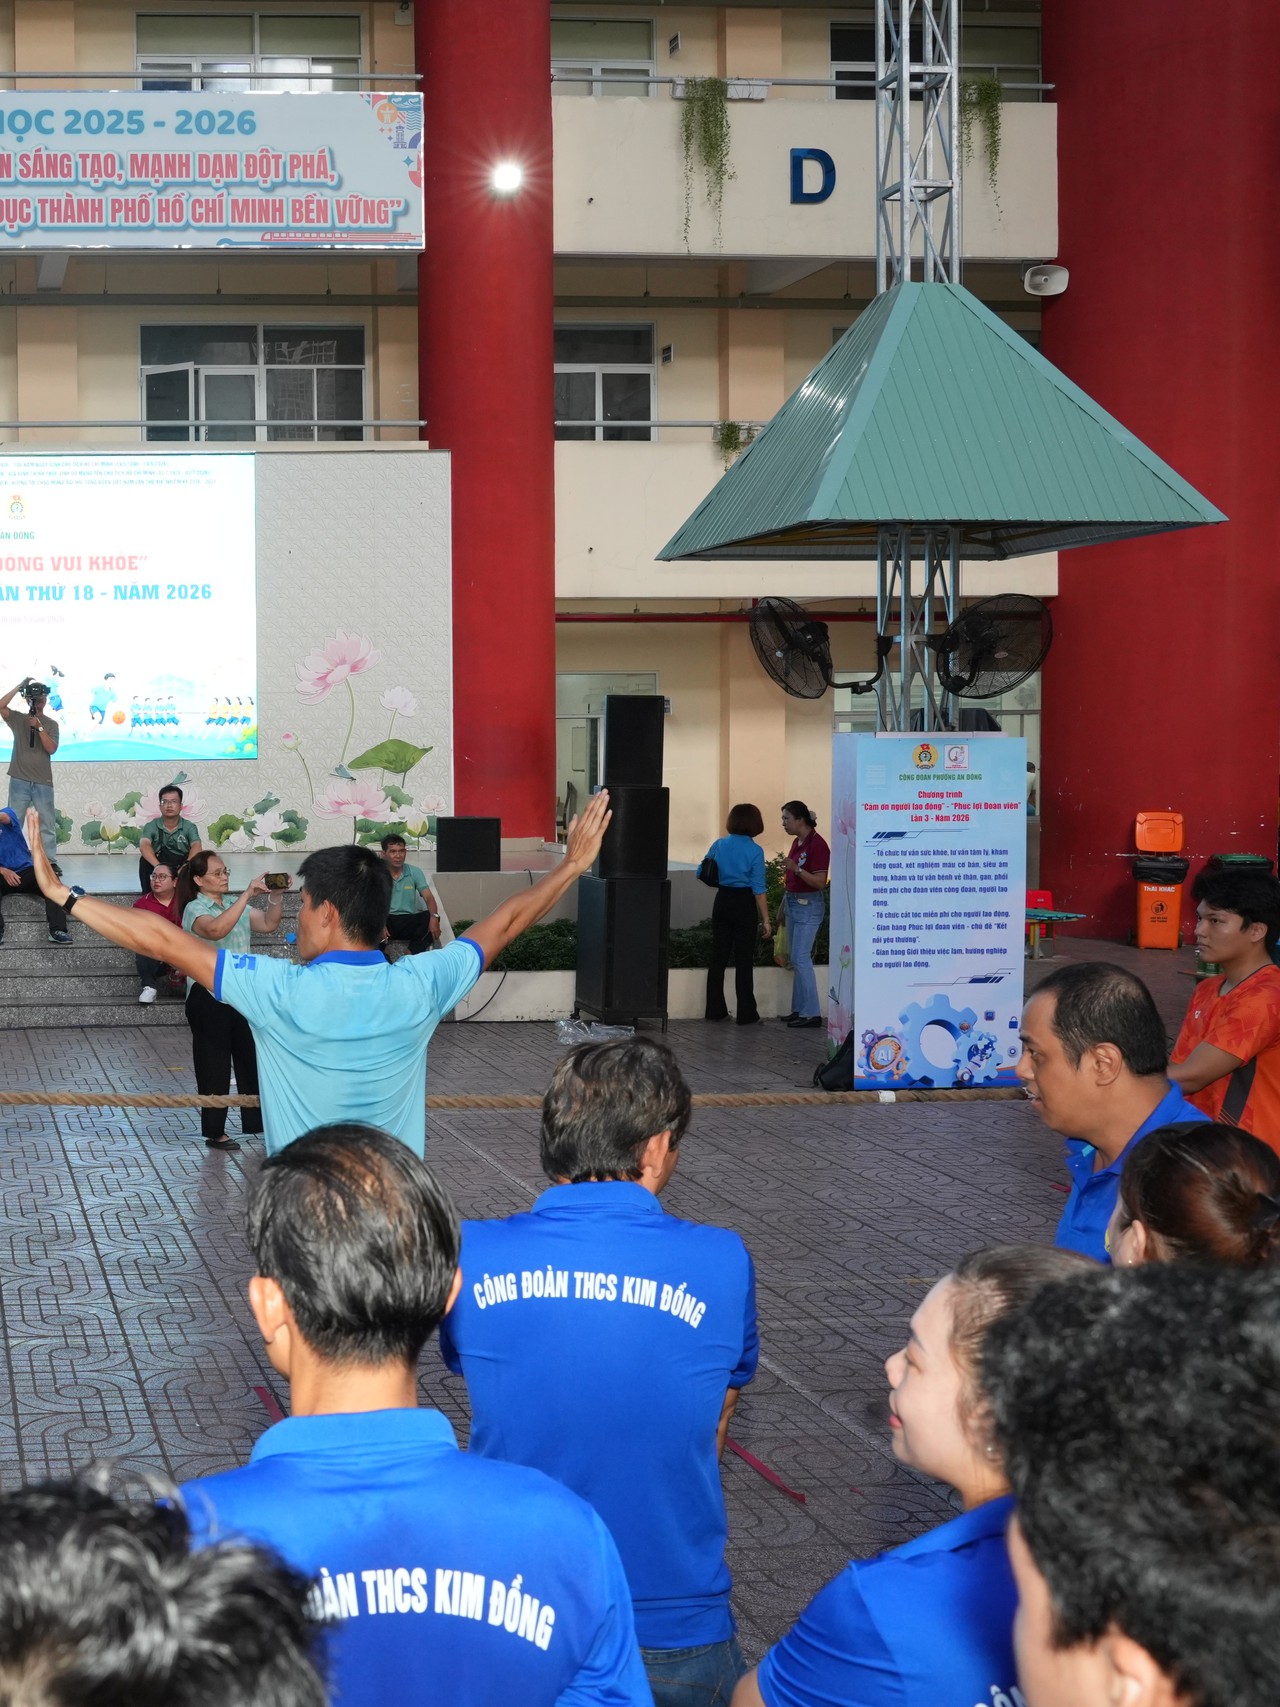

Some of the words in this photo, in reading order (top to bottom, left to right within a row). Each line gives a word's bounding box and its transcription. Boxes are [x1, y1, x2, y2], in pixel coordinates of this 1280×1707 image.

[64, 109, 145, 135] 2025
[154, 120, 165, 128] -
[175, 109, 256, 135] 2026
[19, 148, 72, 179] SÁNG
[79, 152, 123, 184] TẠO,
[130, 152, 190, 184] MẠNH
[198, 152, 236, 184] DẠN
[245, 147, 282, 184] ĐỘT
[289, 147, 336, 183] PHÁ,
[790, 148, 836, 205] D
[38, 192, 103, 224] THÀNH
[111, 191, 156, 224] PHỐ
[158, 191, 186, 224] HỒ
[191, 190, 227, 224] CHÍ
[231, 198, 284, 224] MINH
[291, 192, 328, 224] BỀN
[0, 531, 11, 540] AN
[50, 555, 82, 571] VUI
[74, 586, 95, 601] 18
[113, 581, 160, 601] NĂM
[167, 584, 212, 600] 2026
[473, 1270, 519, 1310] CÔNG
[521, 1265, 569, 1300] ĐOÀN
[573, 1271, 617, 1302] THCS
[621, 1276, 658, 1308] KIM
[659, 1281, 707, 1330] ĐỒNG
[362, 1567, 428, 1615] THCS
[434, 1569, 486, 1621] KIM
[489, 1574, 556, 1652] ĐỒNG
